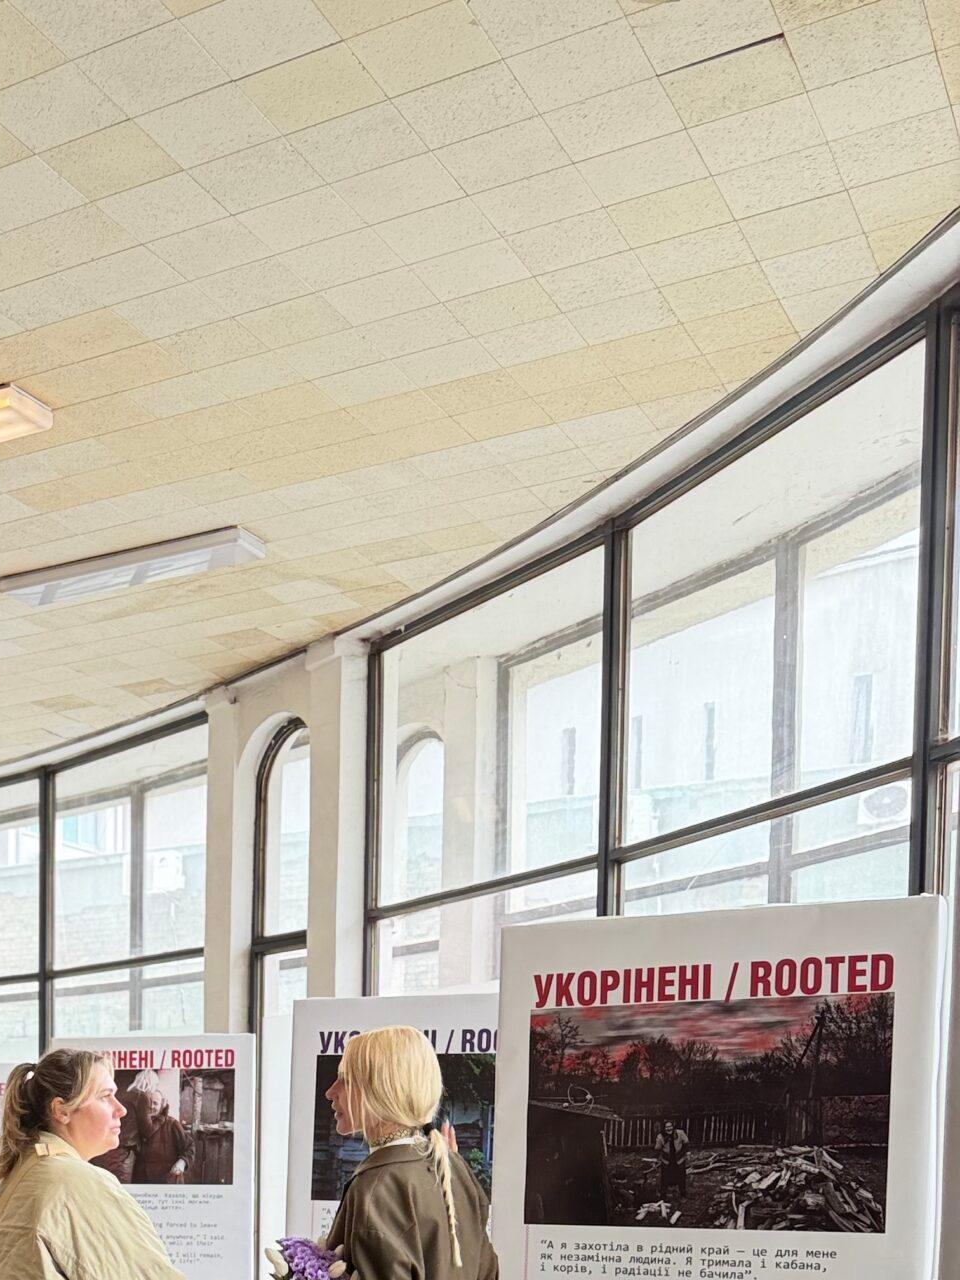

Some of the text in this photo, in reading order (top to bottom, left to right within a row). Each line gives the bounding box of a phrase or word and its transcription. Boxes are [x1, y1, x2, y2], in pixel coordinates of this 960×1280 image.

[533, 953, 894, 1008] УКОРІНЕНІ / ROOTED
[160, 1050, 166, 1070] /
[171, 1049, 235, 1069] ROOTED
[560, 1242, 567, 1250] я
[573, 1241, 630, 1252] захотіла
[636, 1244, 644, 1252] в
[650, 1243, 693, 1255] рідний
[700, 1245, 730, 1260] край
[752, 1247, 768, 1259] це
[775, 1248, 798, 1259] для
[805, 1250, 837, 1259] мене
[540, 1252, 553, 1261] як
[560, 1253, 622, 1263] незамінна
[628, 1256, 677, 1266] людина.
[685, 1256, 693, 1265] Я
[700, 1258, 752, 1269] тримала
[775, 1259, 828, 1273] кабана,
[553, 1264, 593, 1275] корів,
[614, 1266, 671, 1279] радіації
[678, 1269, 693, 1278] не
